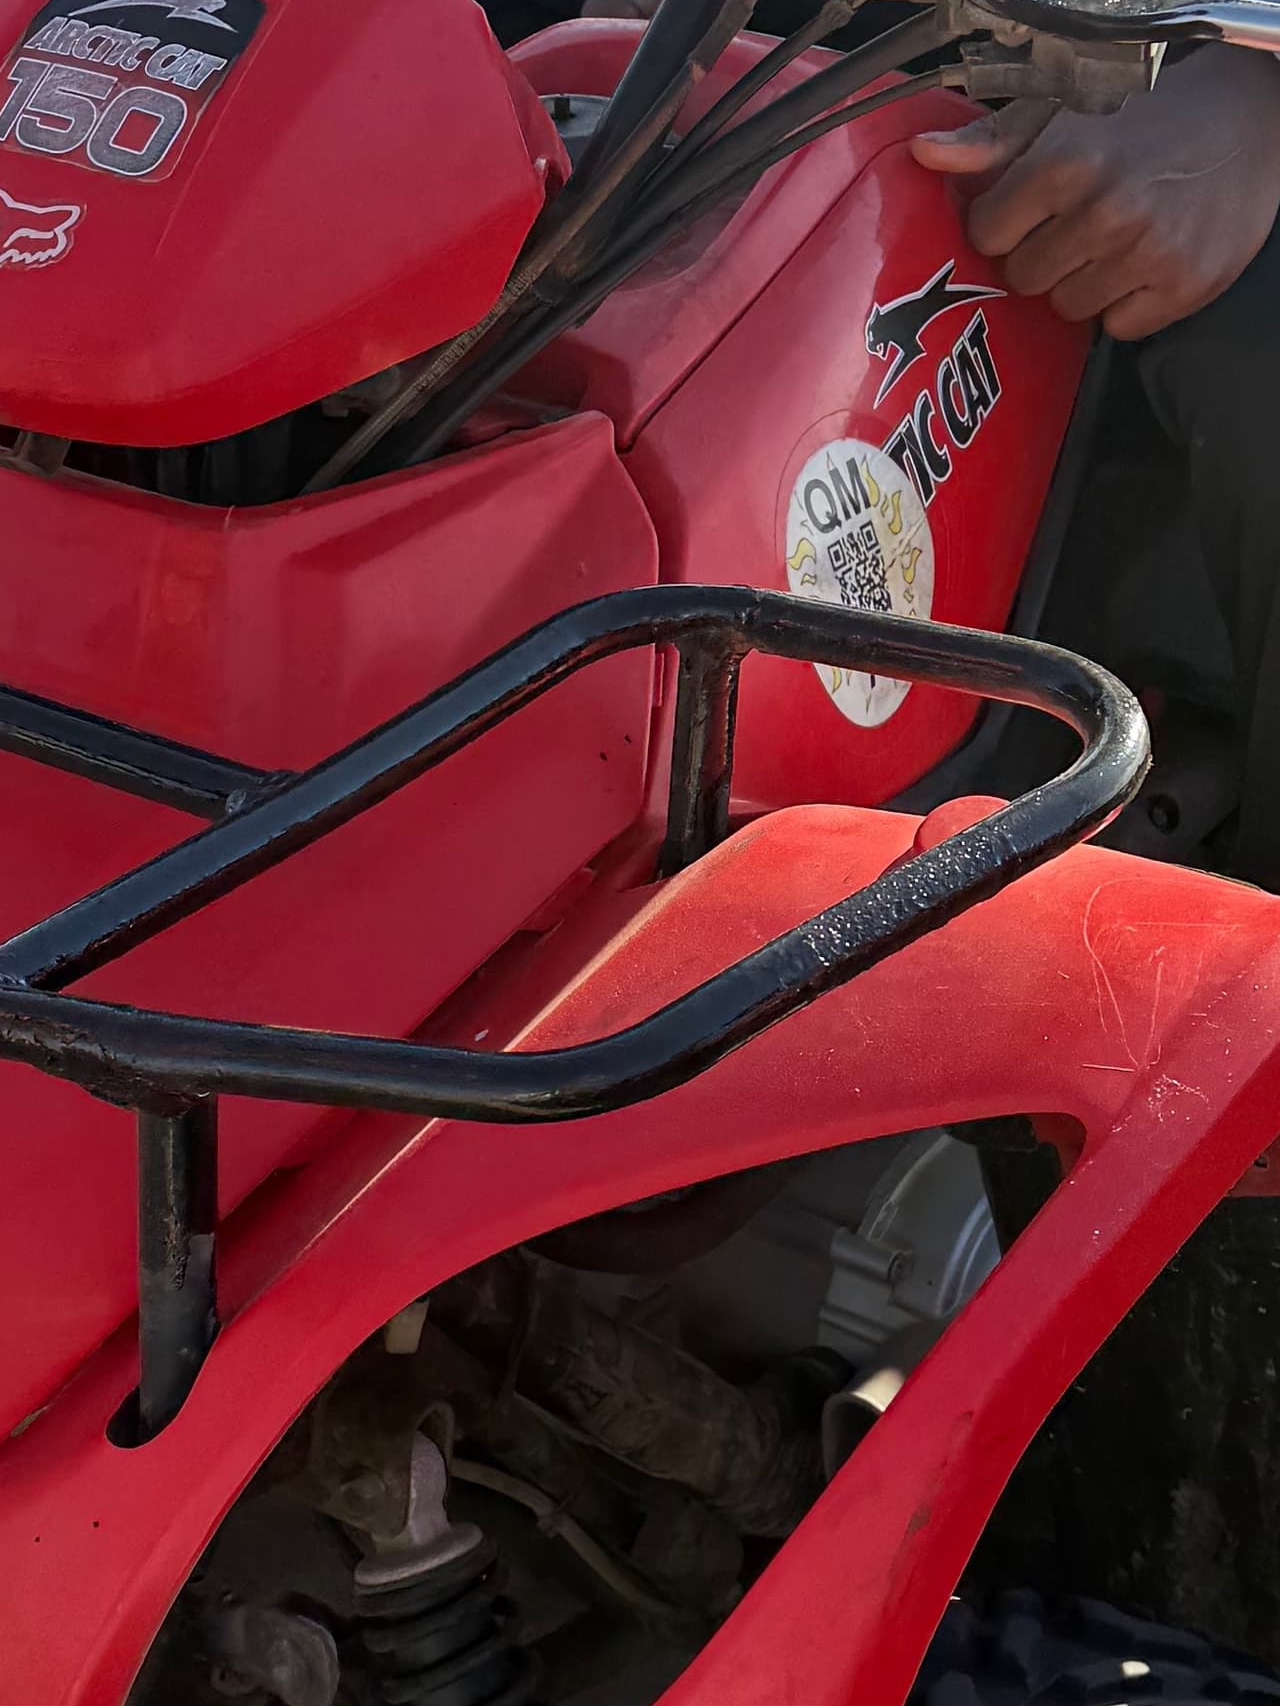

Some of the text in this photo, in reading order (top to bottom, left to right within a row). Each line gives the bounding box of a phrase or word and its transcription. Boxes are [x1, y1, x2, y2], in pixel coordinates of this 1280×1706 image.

[23, 15, 229, 90] ARCTIC CAT
[936, 307, 1003, 450] CAT
[803, 457, 873, 534] QM
